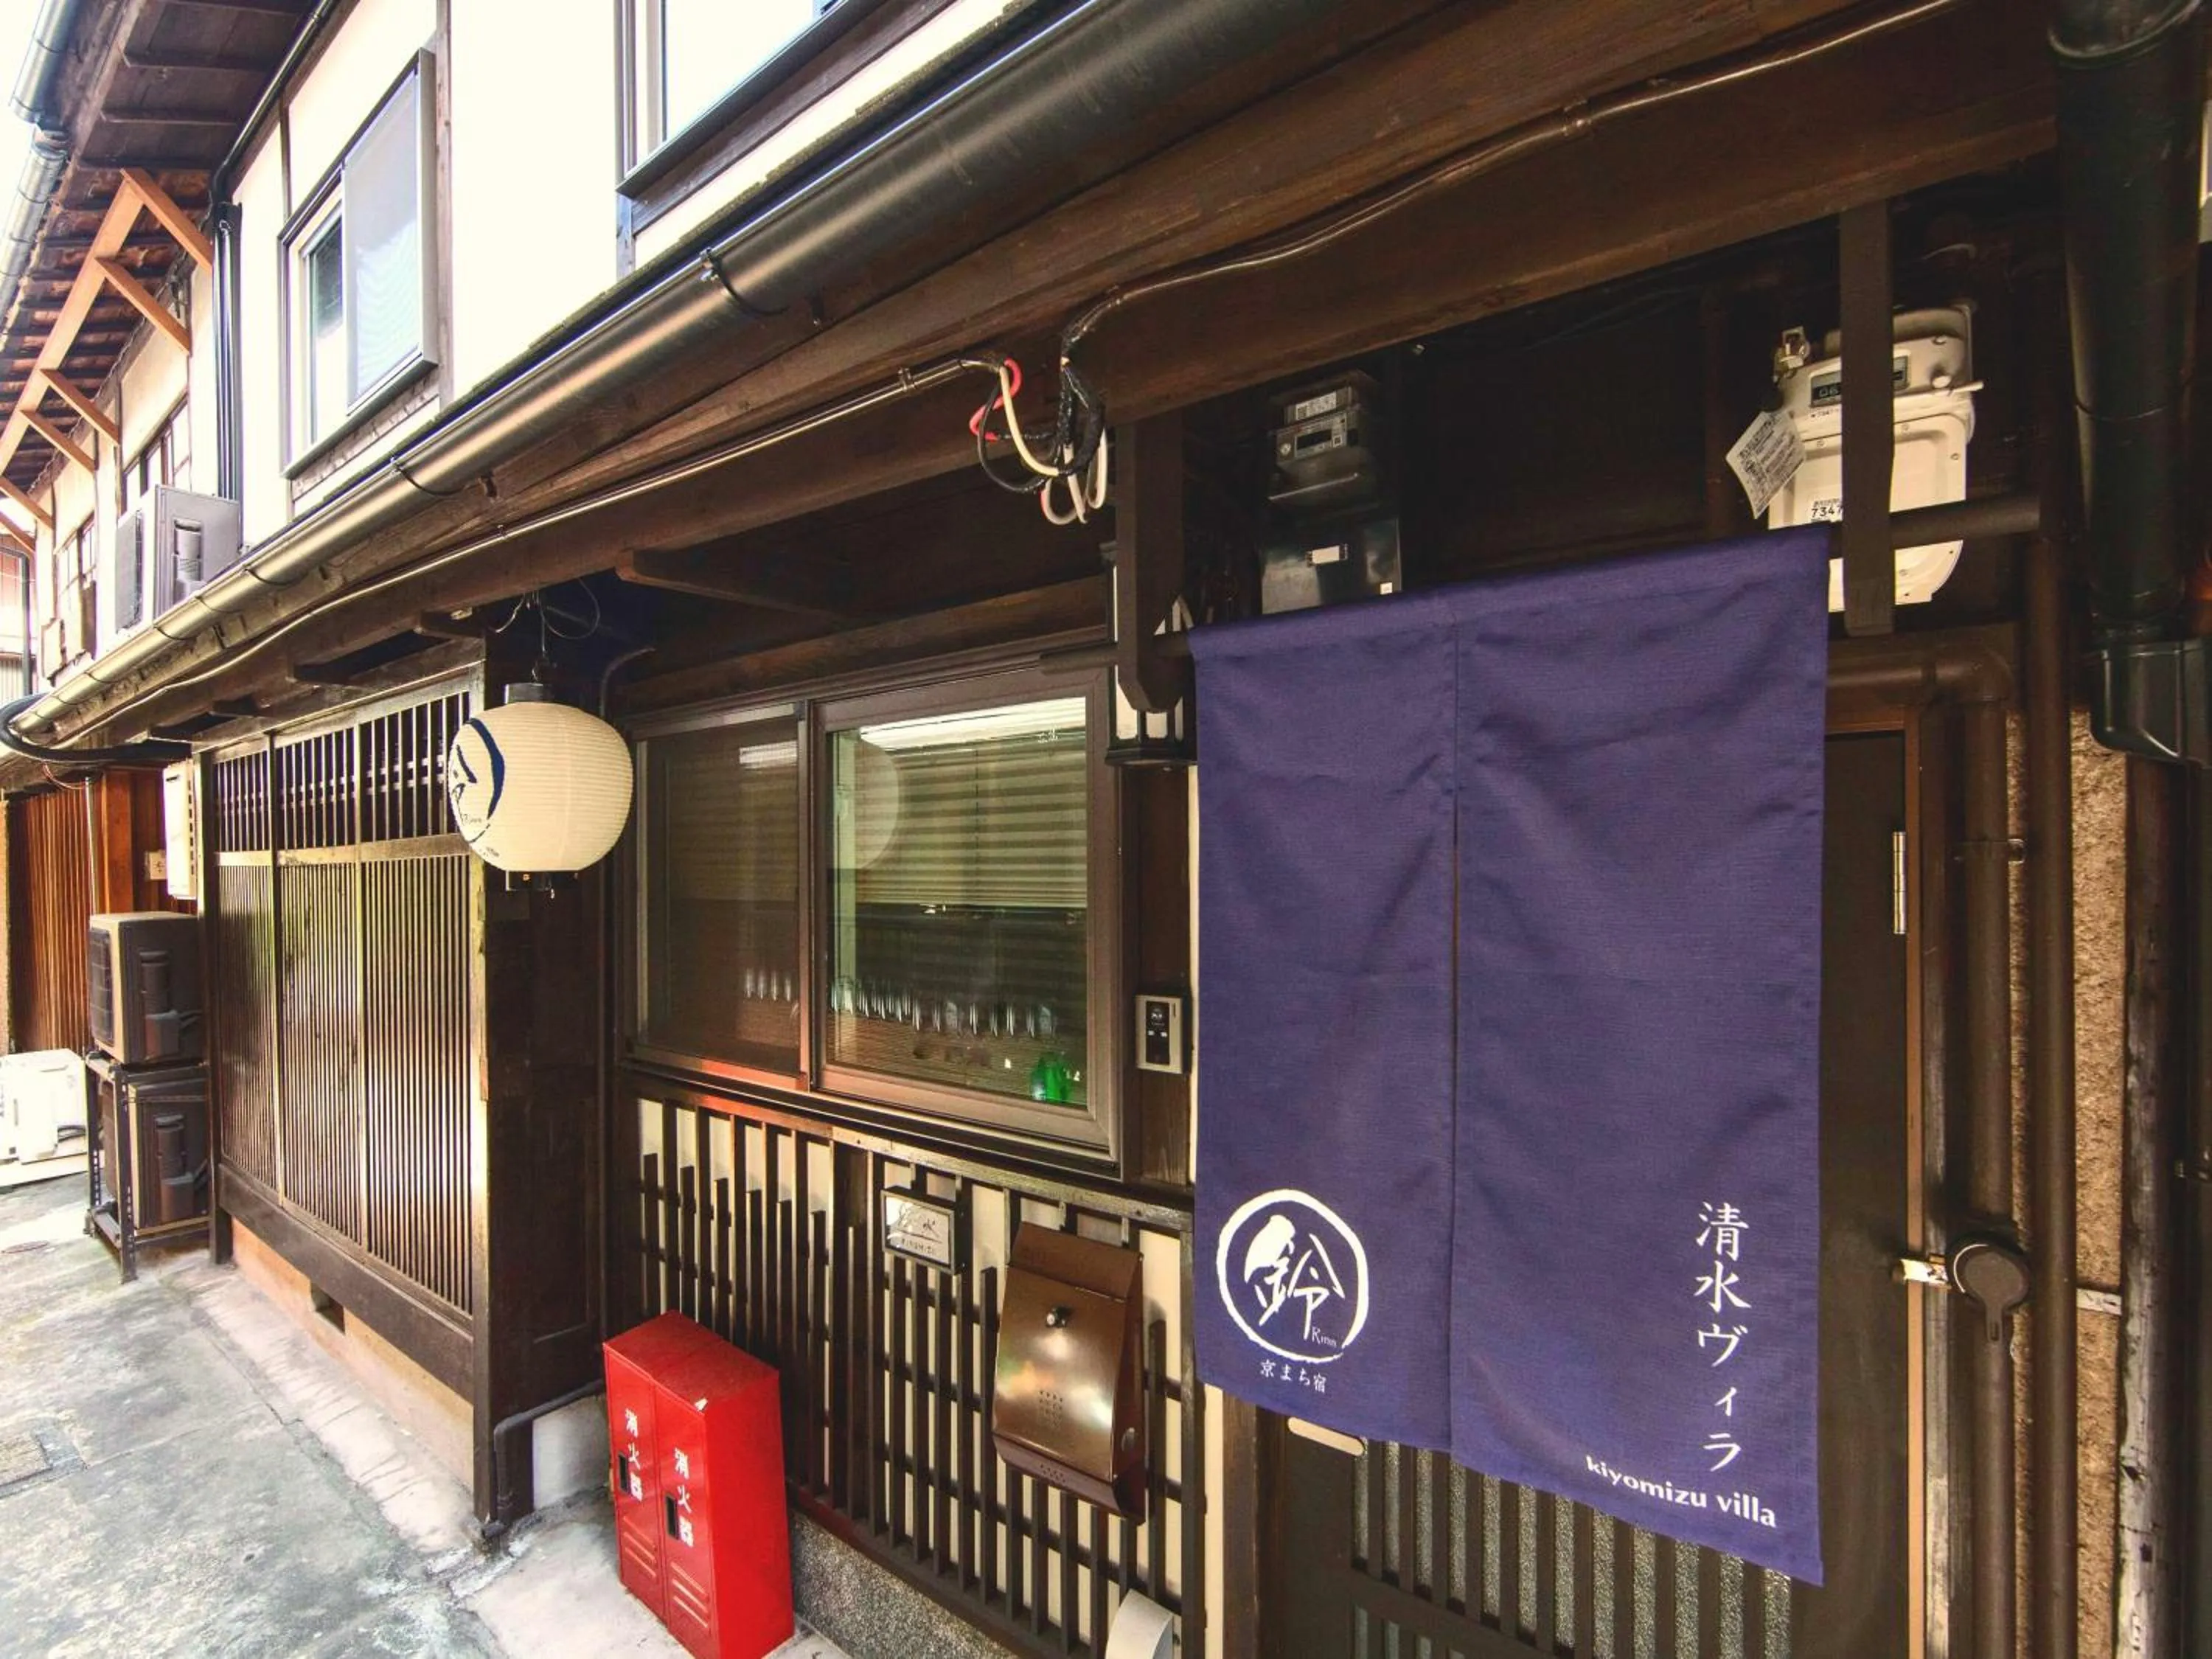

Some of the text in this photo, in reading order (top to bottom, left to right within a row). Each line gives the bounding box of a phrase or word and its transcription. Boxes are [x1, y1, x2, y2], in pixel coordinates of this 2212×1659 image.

[1694, 1201, 1752, 1472] 清水ヴィラ
[1259, 1358, 1327, 1394] 京まち宿
[1585, 1454, 1777, 1528] kiyomizu villa
